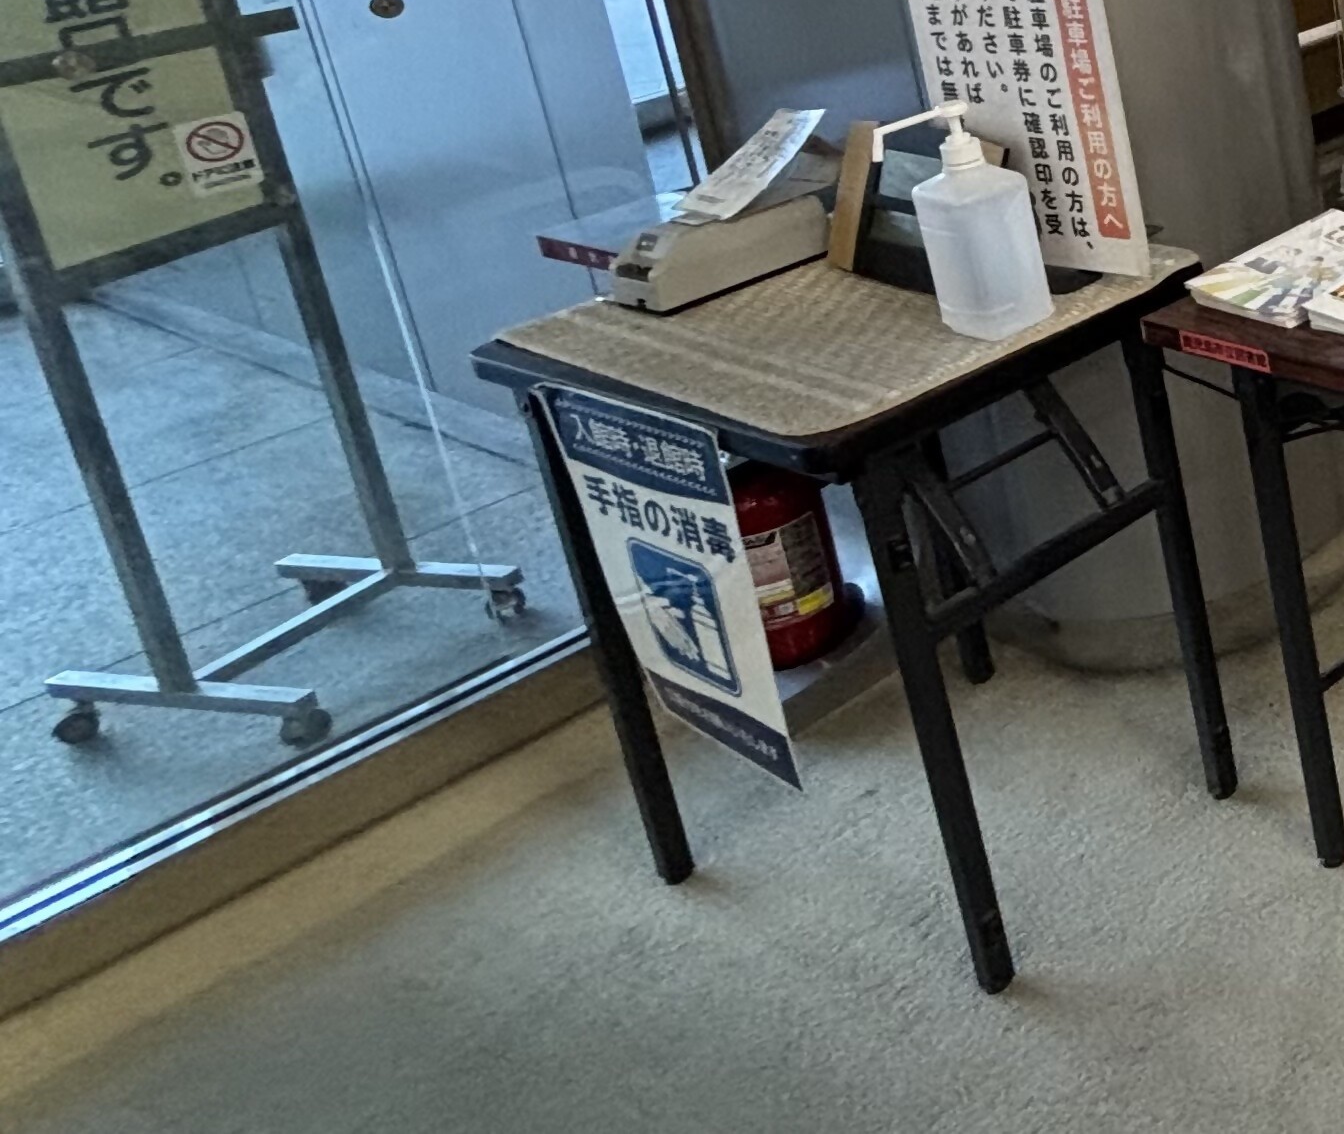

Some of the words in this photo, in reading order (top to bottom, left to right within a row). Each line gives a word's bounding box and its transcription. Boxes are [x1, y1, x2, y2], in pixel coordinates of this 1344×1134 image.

[583, 474, 737, 564] 手指の消毒
